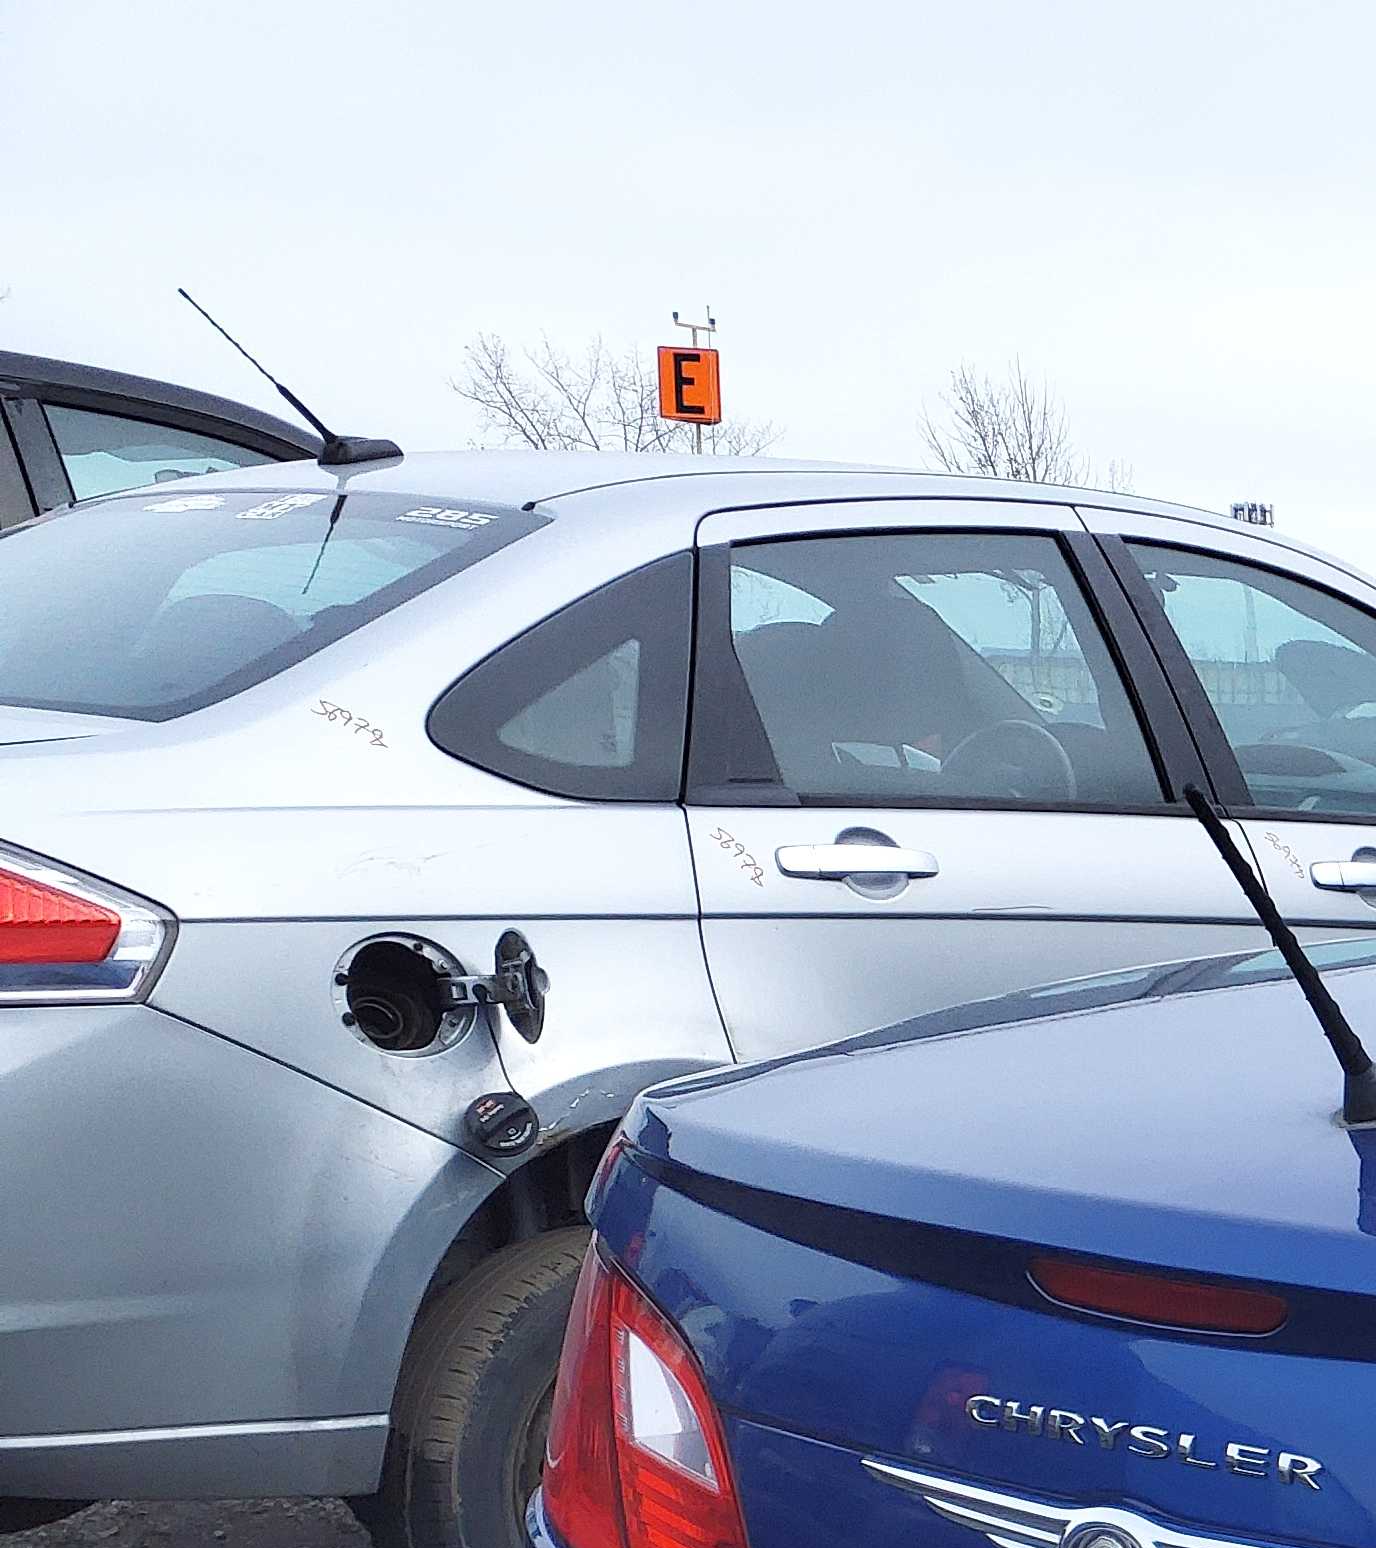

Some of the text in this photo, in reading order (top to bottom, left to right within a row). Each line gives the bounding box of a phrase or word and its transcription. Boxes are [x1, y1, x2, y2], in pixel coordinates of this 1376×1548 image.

[673, 353, 705, 414] E
[403, 506, 500, 526] 285
[310, 699, 388, 748] 56978
[709, 827, 764, 887] 56978
[965, 1394, 1325, 1491] CHRYSLER
